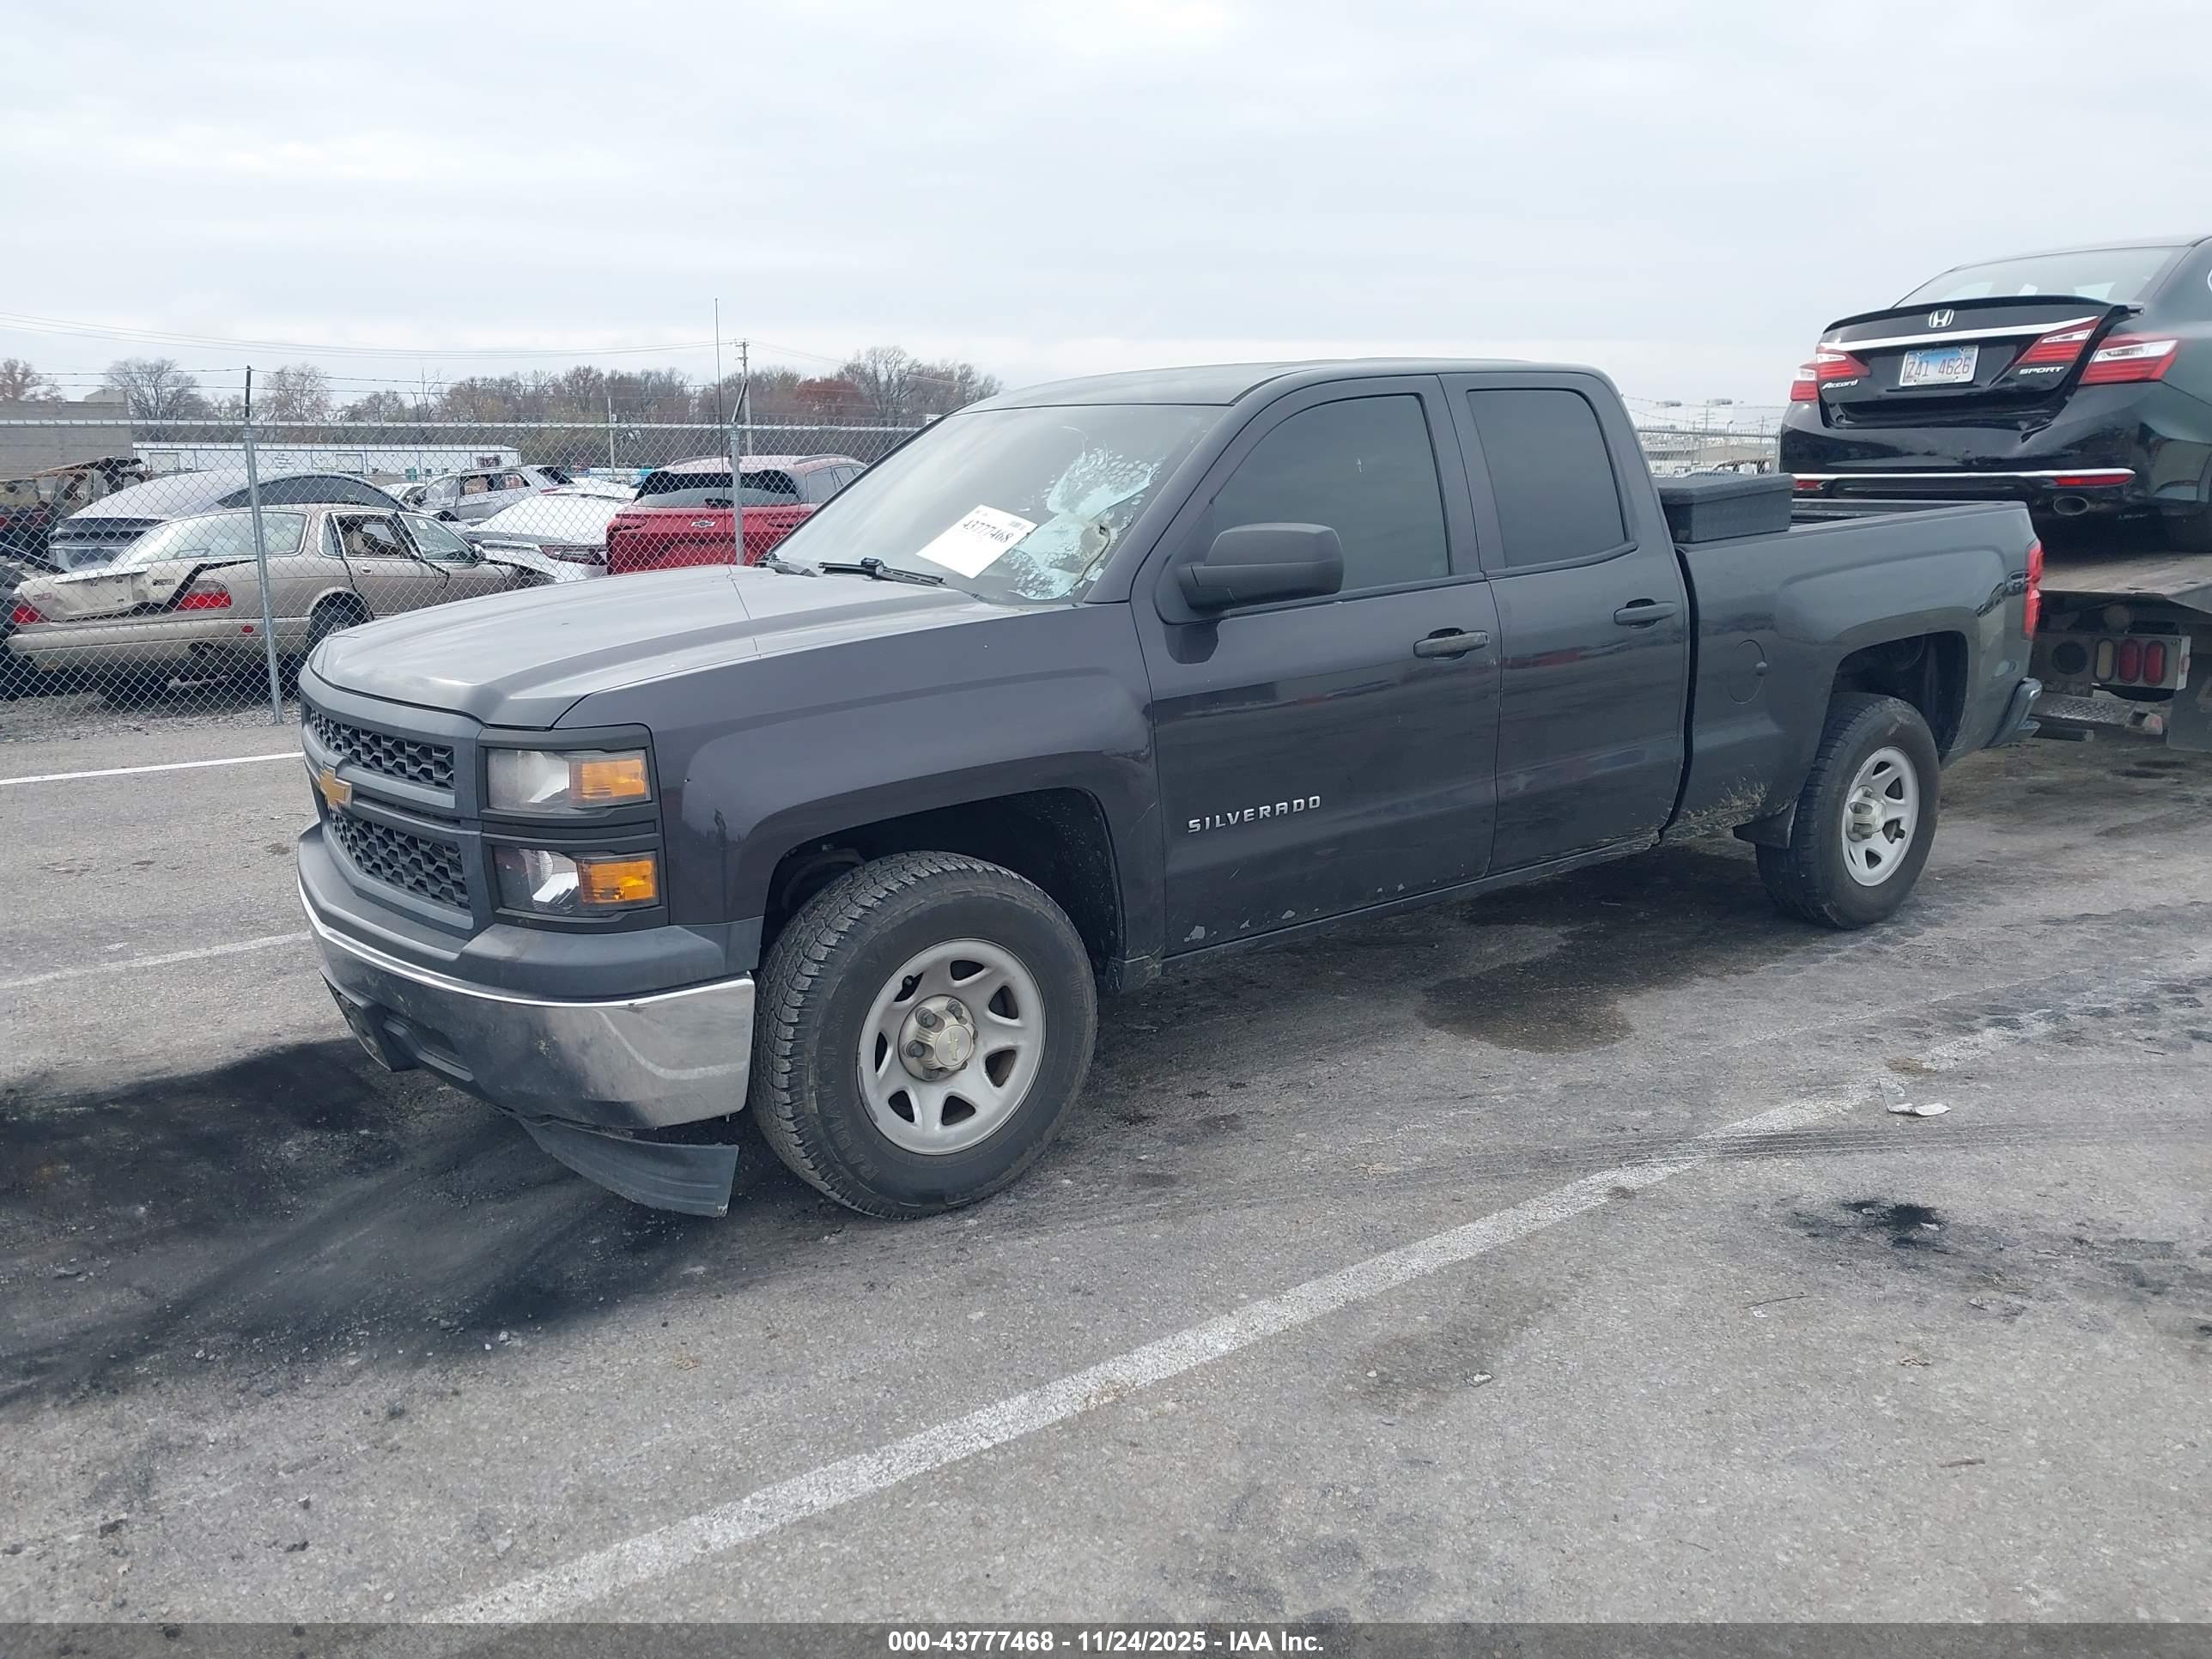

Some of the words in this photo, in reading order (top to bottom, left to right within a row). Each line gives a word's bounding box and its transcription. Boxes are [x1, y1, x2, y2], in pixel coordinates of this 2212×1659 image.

[1906, 360, 1929, 379] Z41
[1937, 356, 1972, 375] 4626
[2019, 366, 2064, 375] SPORT
[1821, 379, 1858, 390] Accord
[963, 520, 1014, 544] 43777468
[1188, 795, 1322, 834] SILVERADO
